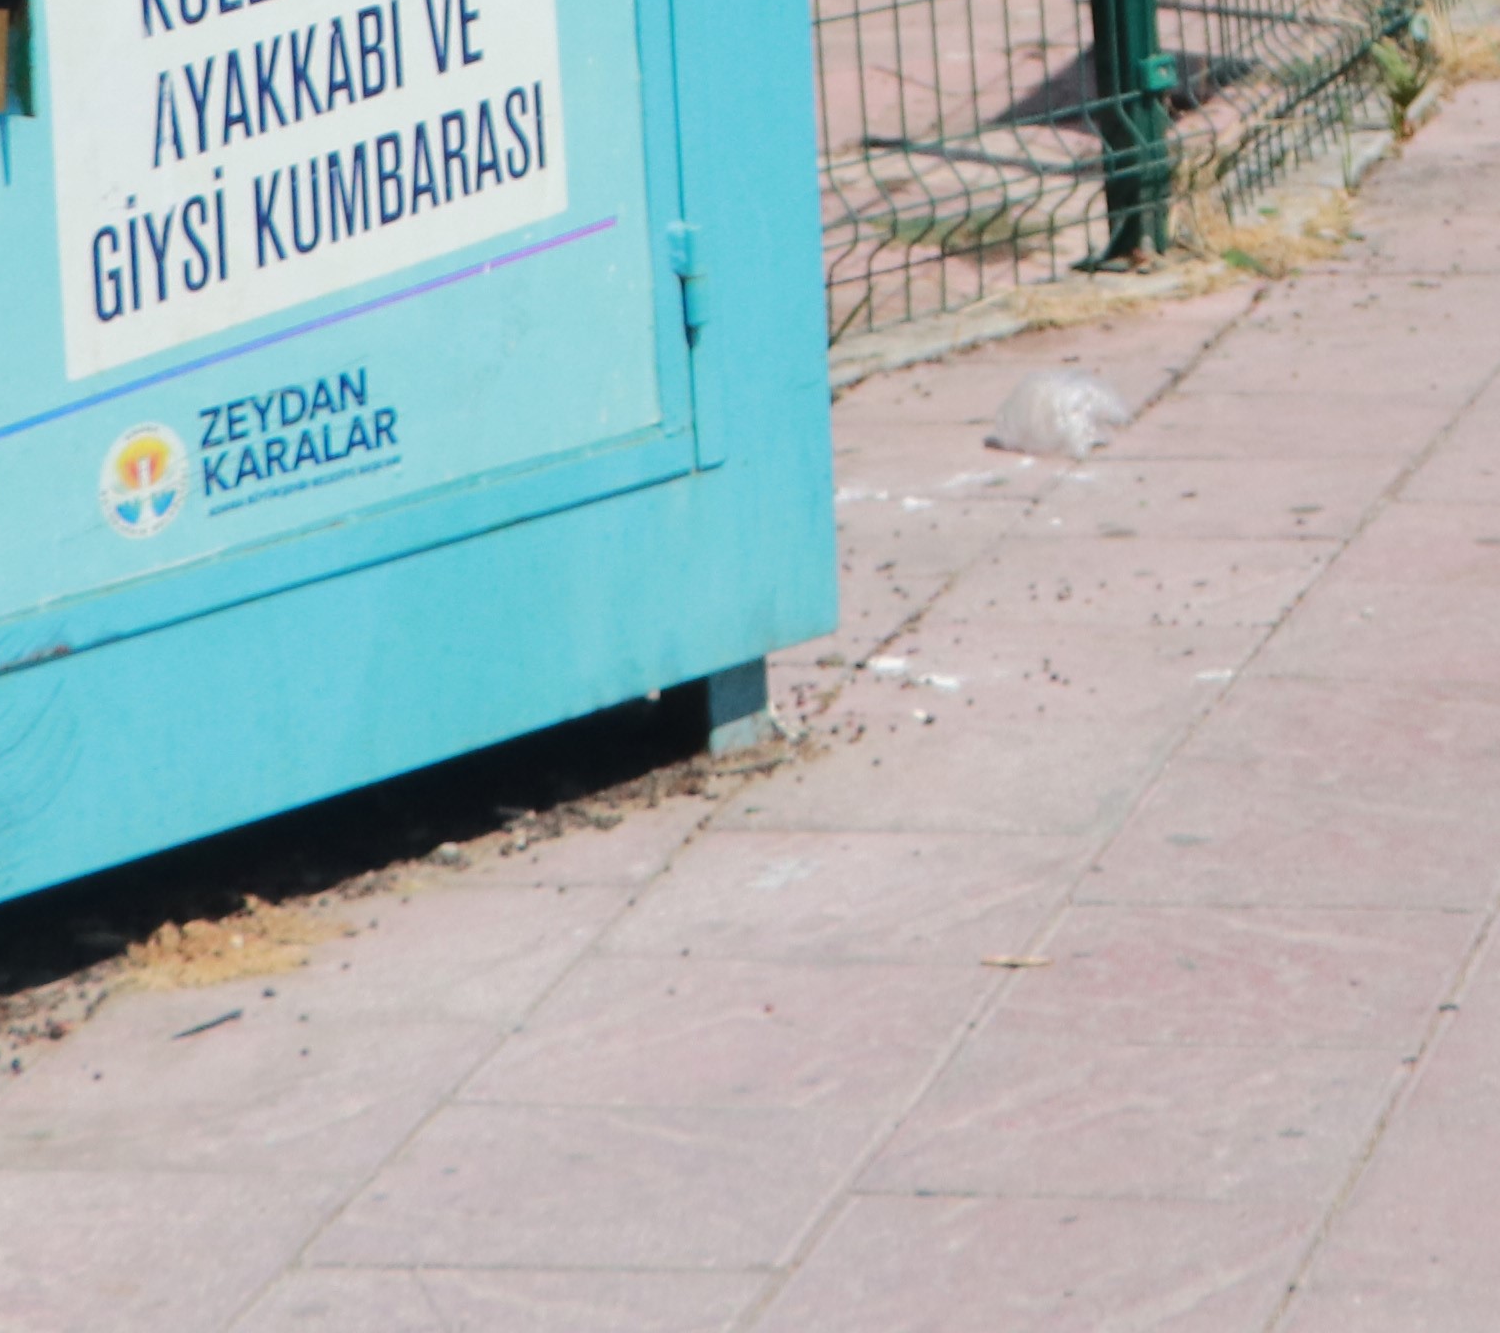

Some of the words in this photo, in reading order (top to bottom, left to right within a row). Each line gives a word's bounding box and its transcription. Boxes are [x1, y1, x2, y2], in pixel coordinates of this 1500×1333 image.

[91, 165, 230, 324] GİYSİ
[252, 79, 548, 270] KUMBARASI
[197, 364, 369, 450] ZEYDAN
[202, 406, 399, 497] KARALAR
